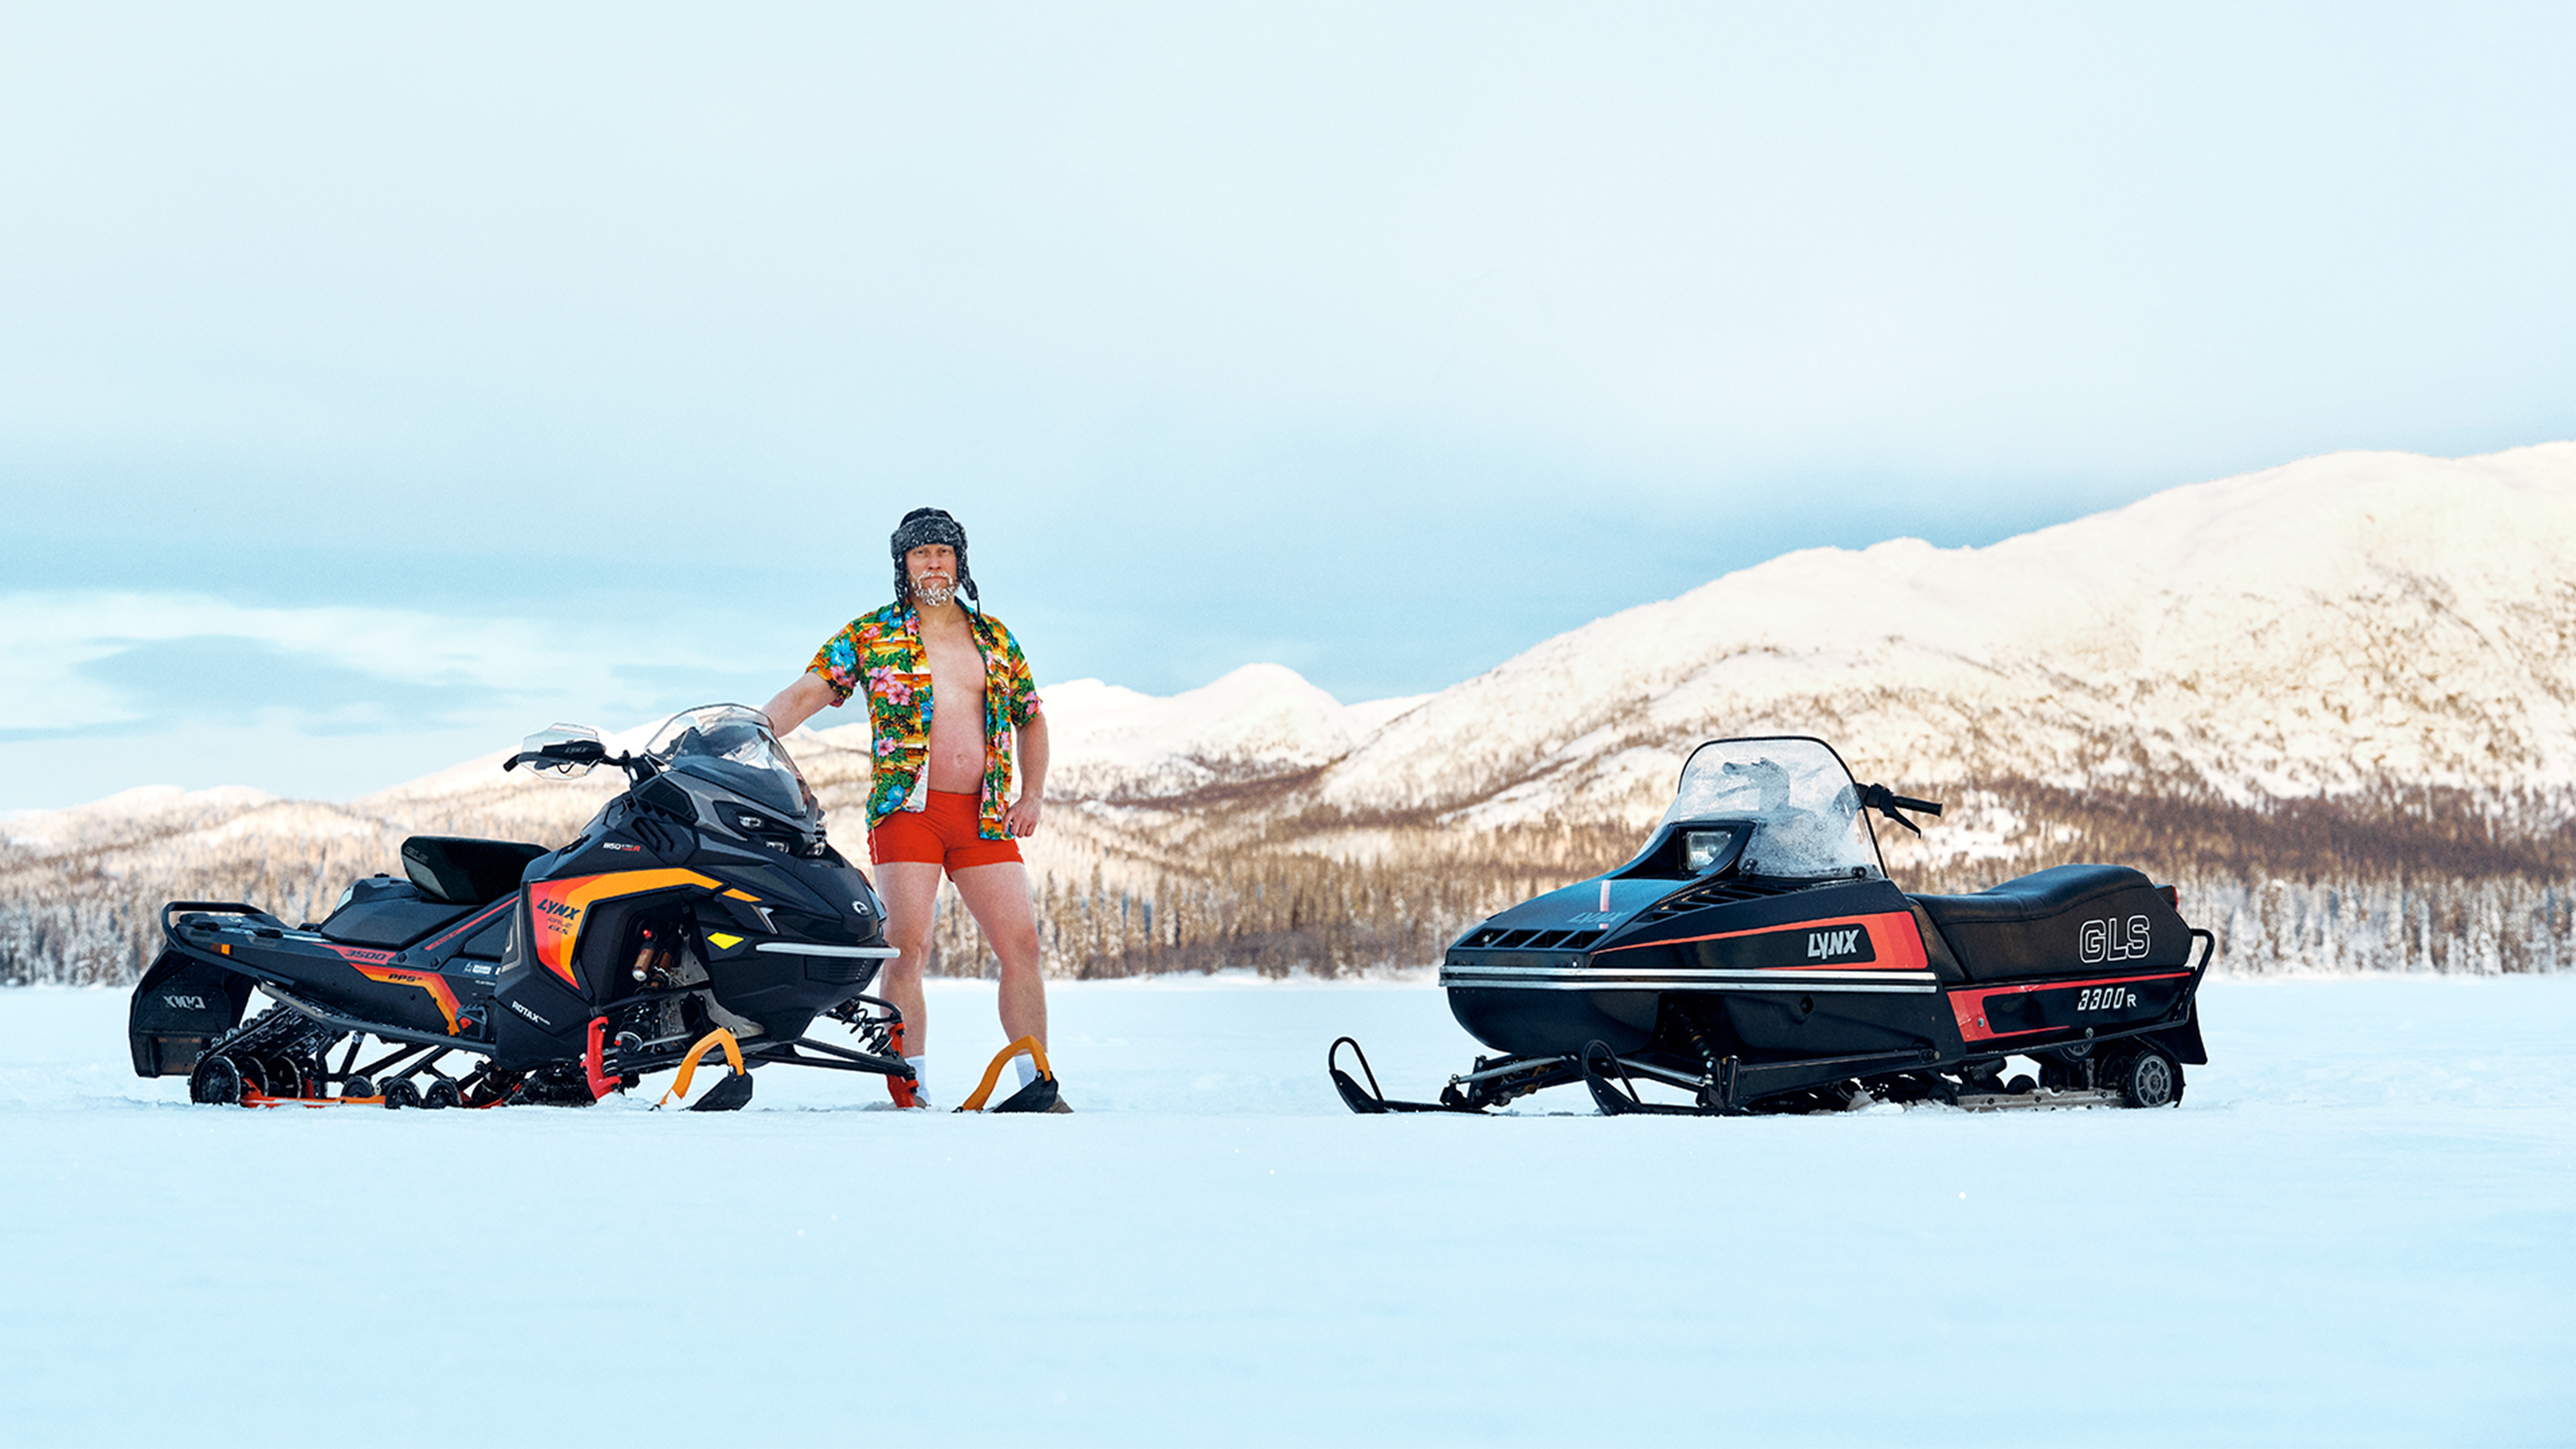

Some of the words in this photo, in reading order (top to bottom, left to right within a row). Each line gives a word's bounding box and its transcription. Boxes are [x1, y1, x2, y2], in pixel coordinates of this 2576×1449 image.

[602, 842, 621, 850] 850
[536, 898, 581, 921] LYNX
[1566, 911, 1630, 925] LYNX
[1807, 929, 1860, 960] LYNX
[2079, 914, 2150, 963] GLS
[345, 949, 387, 961] 3500
[2077, 987, 2126, 1011] 3300
[512, 1000, 539, 1023] ROTAX
